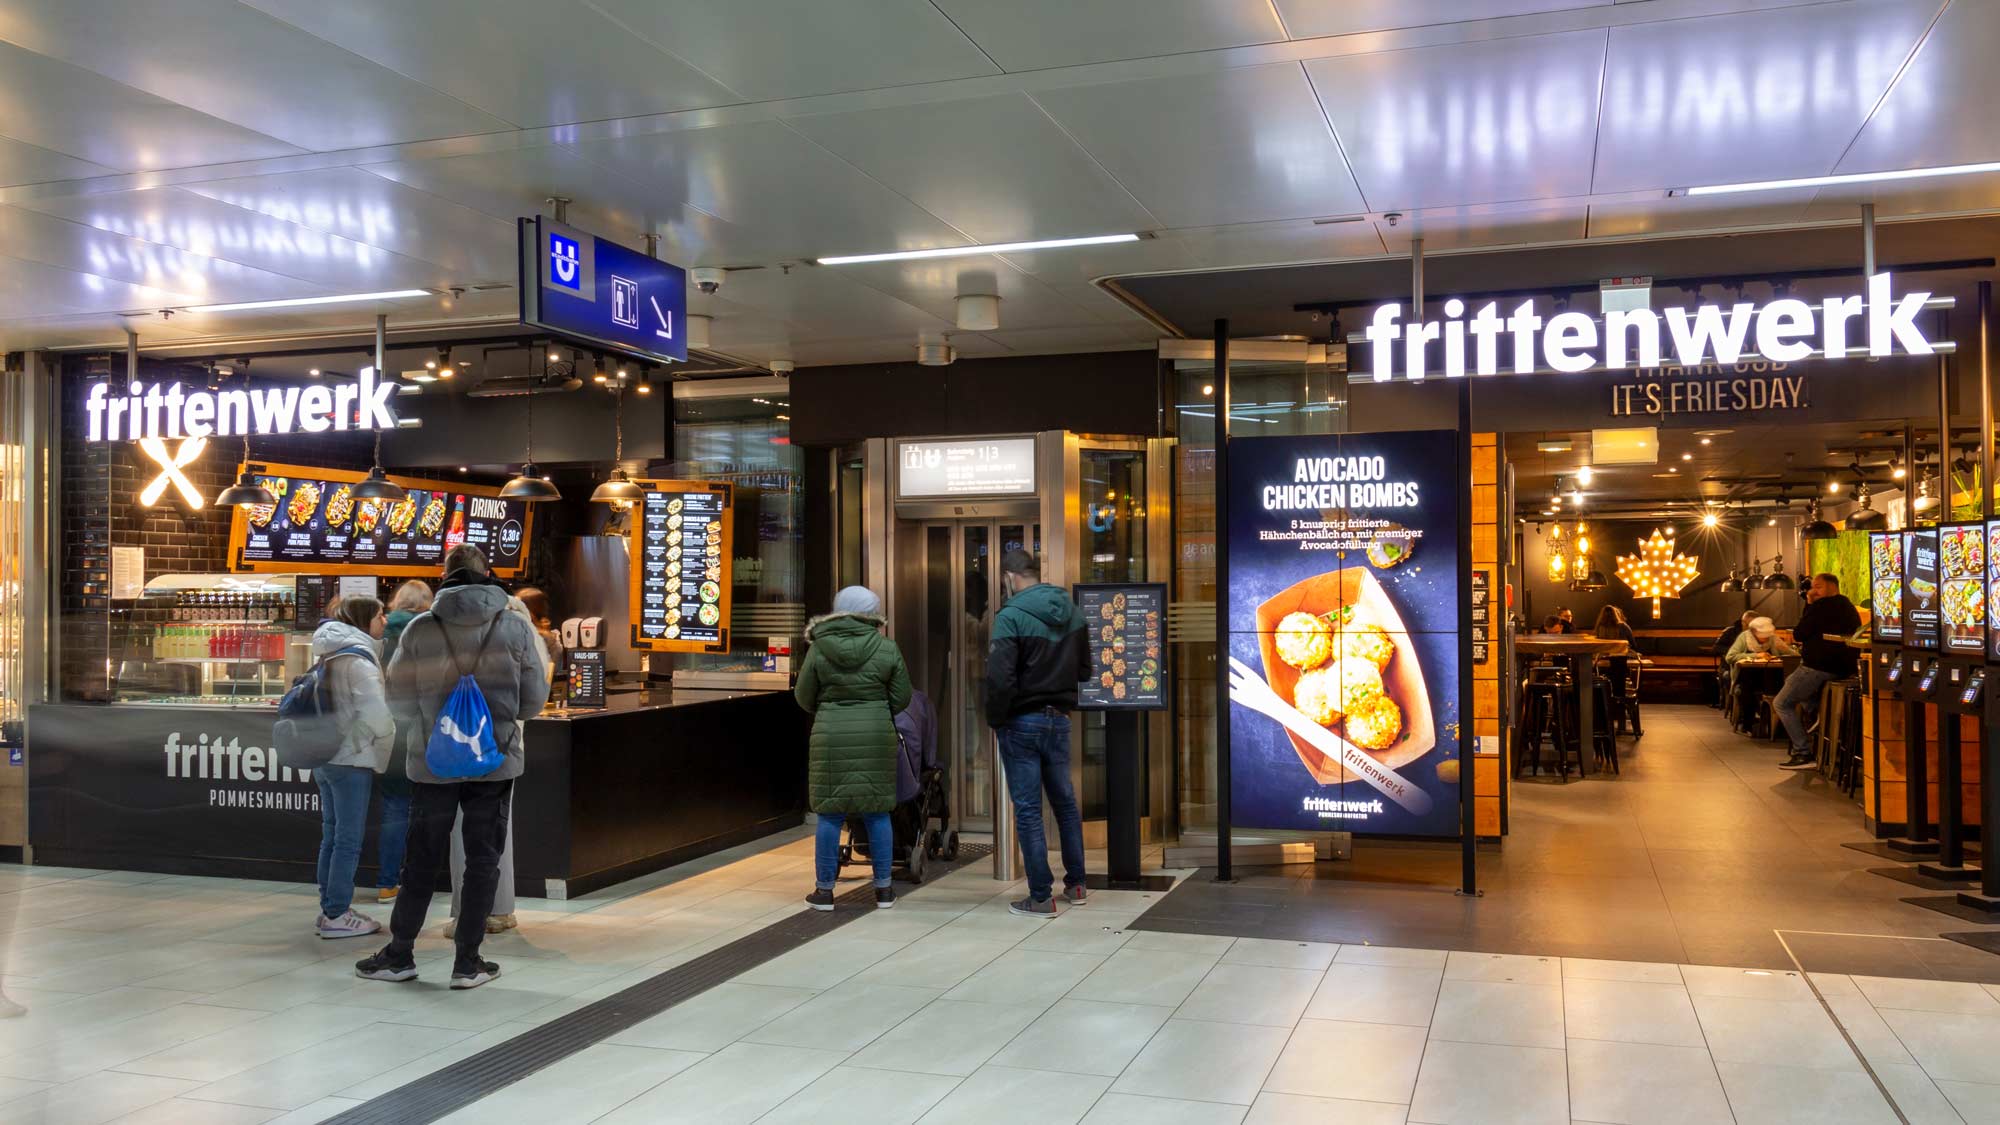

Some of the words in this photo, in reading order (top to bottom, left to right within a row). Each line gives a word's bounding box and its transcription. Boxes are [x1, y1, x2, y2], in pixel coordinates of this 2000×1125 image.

[1366, 272, 1935, 381] frittenwerk
[87, 367, 398, 441] frittenwerk
[1612, 383, 1661, 416] IT'S
[1671, 377, 1808, 412] FRIESDAY.
[1294, 456, 1385, 482] AVOCADO
[470, 498, 507, 519] DRINKS
[1263, 484, 1345, 510] CHICKEN
[1350, 482, 1419, 508] BOMBS
[1260, 530, 1354, 543] Hähnchenbällchen
[1356, 530, 1373, 541] mit
[1374, 529, 1424, 543] cremiger
[1290, 519, 1298, 529] 5
[1299, 519, 1346, 531] knusprig
[1347, 518, 1390, 529] frittierte
[1300, 539, 1381, 551] Avocadofüllung
[165, 732, 312, 783] fritten
[1344, 749, 1405, 797] frittenwerk
[210, 789, 325, 811] POMMESMANUFA
[1303, 796, 1383, 813] frittenwerk
